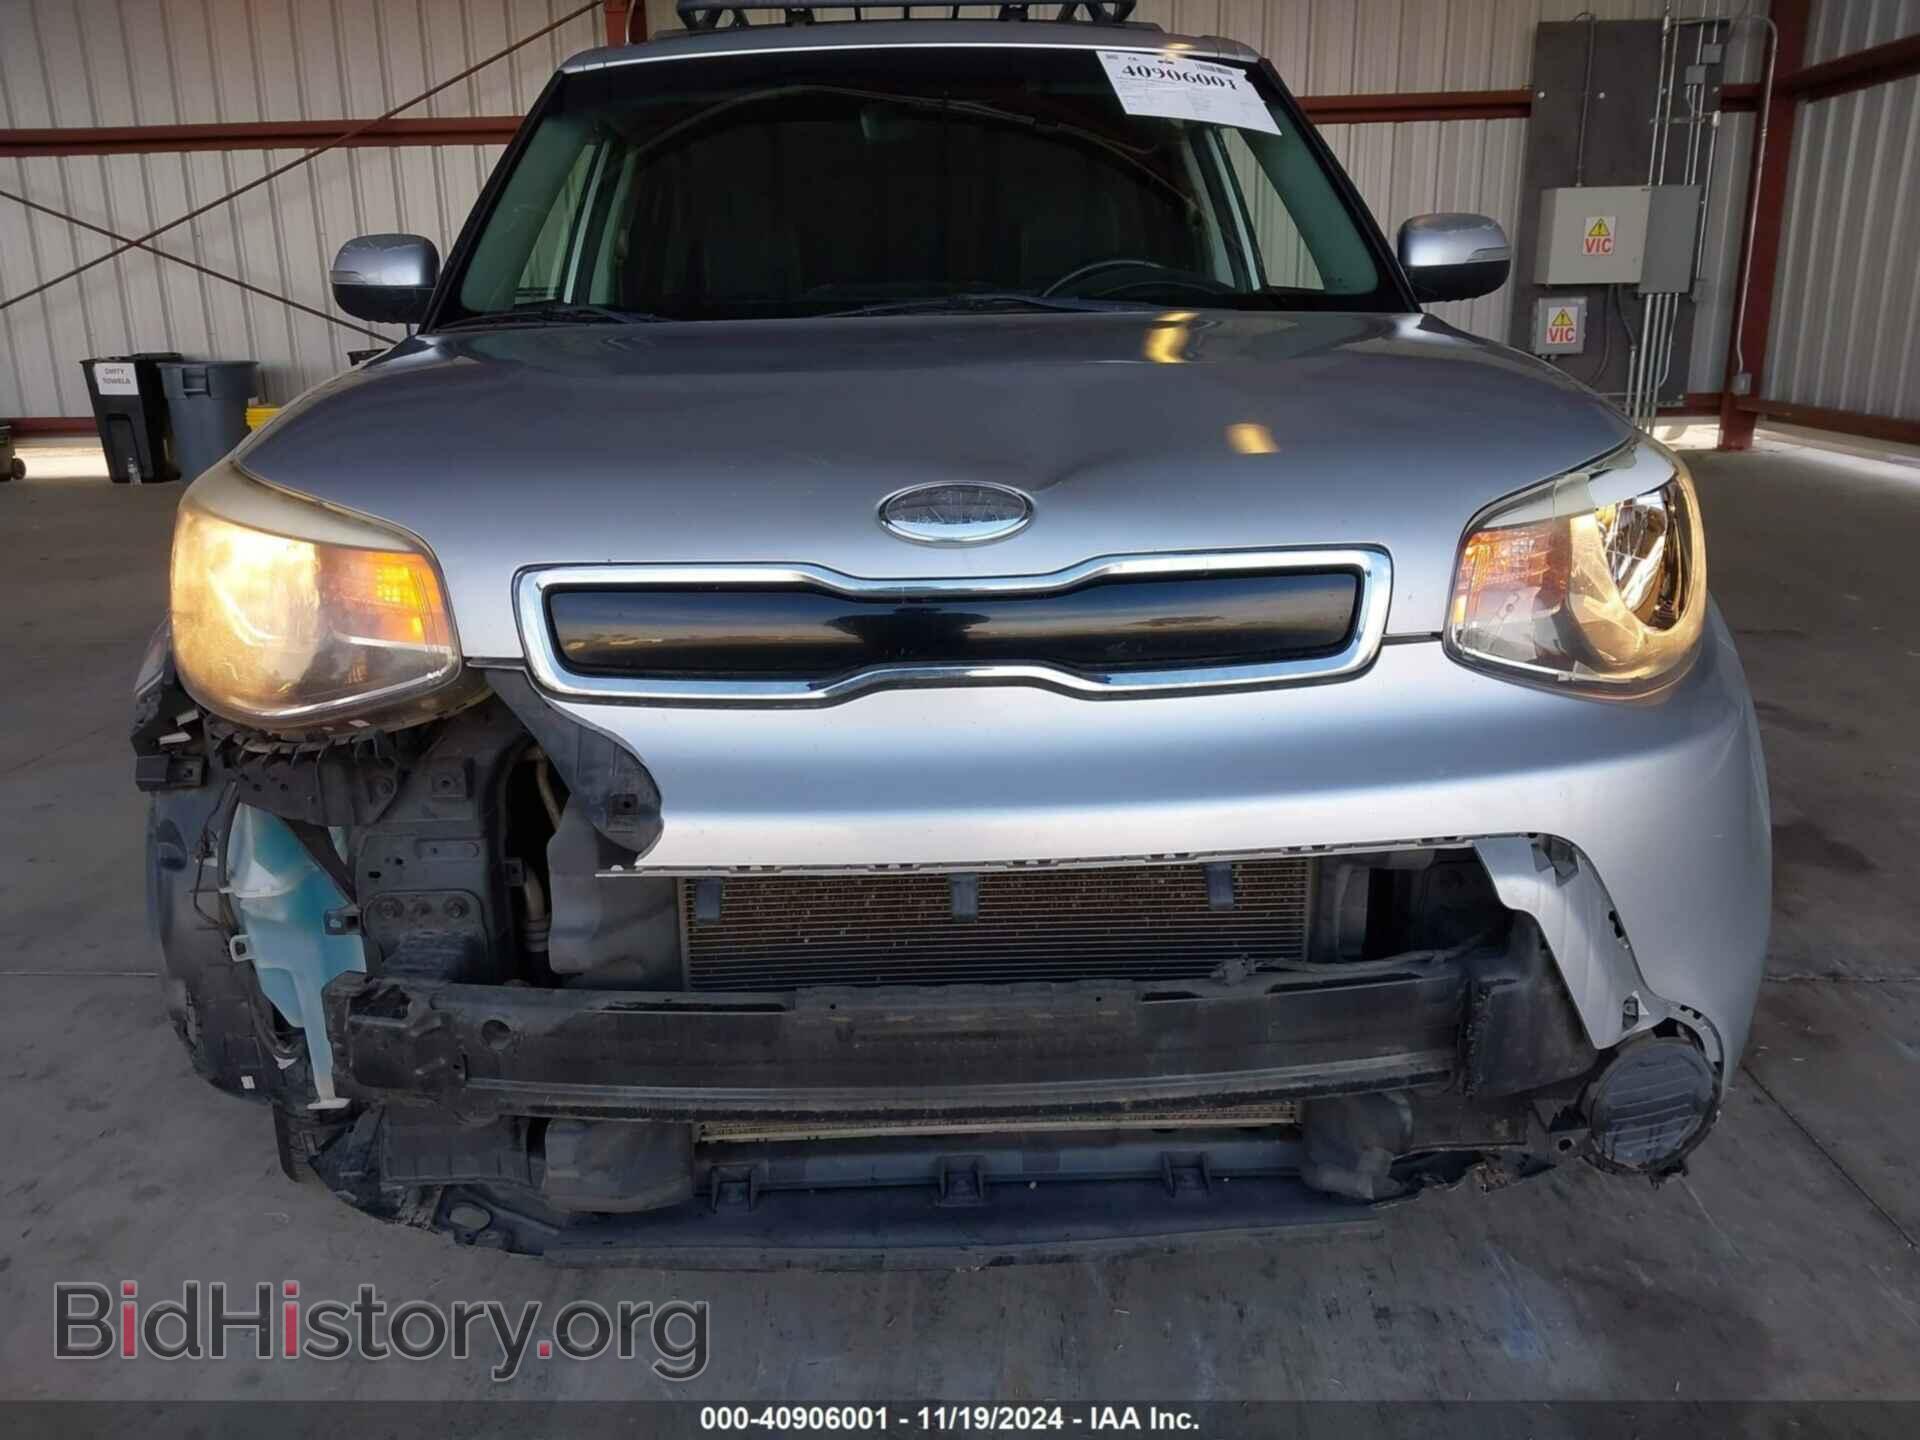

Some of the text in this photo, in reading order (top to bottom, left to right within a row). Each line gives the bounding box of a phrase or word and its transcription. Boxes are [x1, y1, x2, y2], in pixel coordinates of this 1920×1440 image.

[1122, 64, 1238, 91] 40906001
[1585, 238, 1612, 253] VIC
[1549, 327, 1575, 342] VIC
